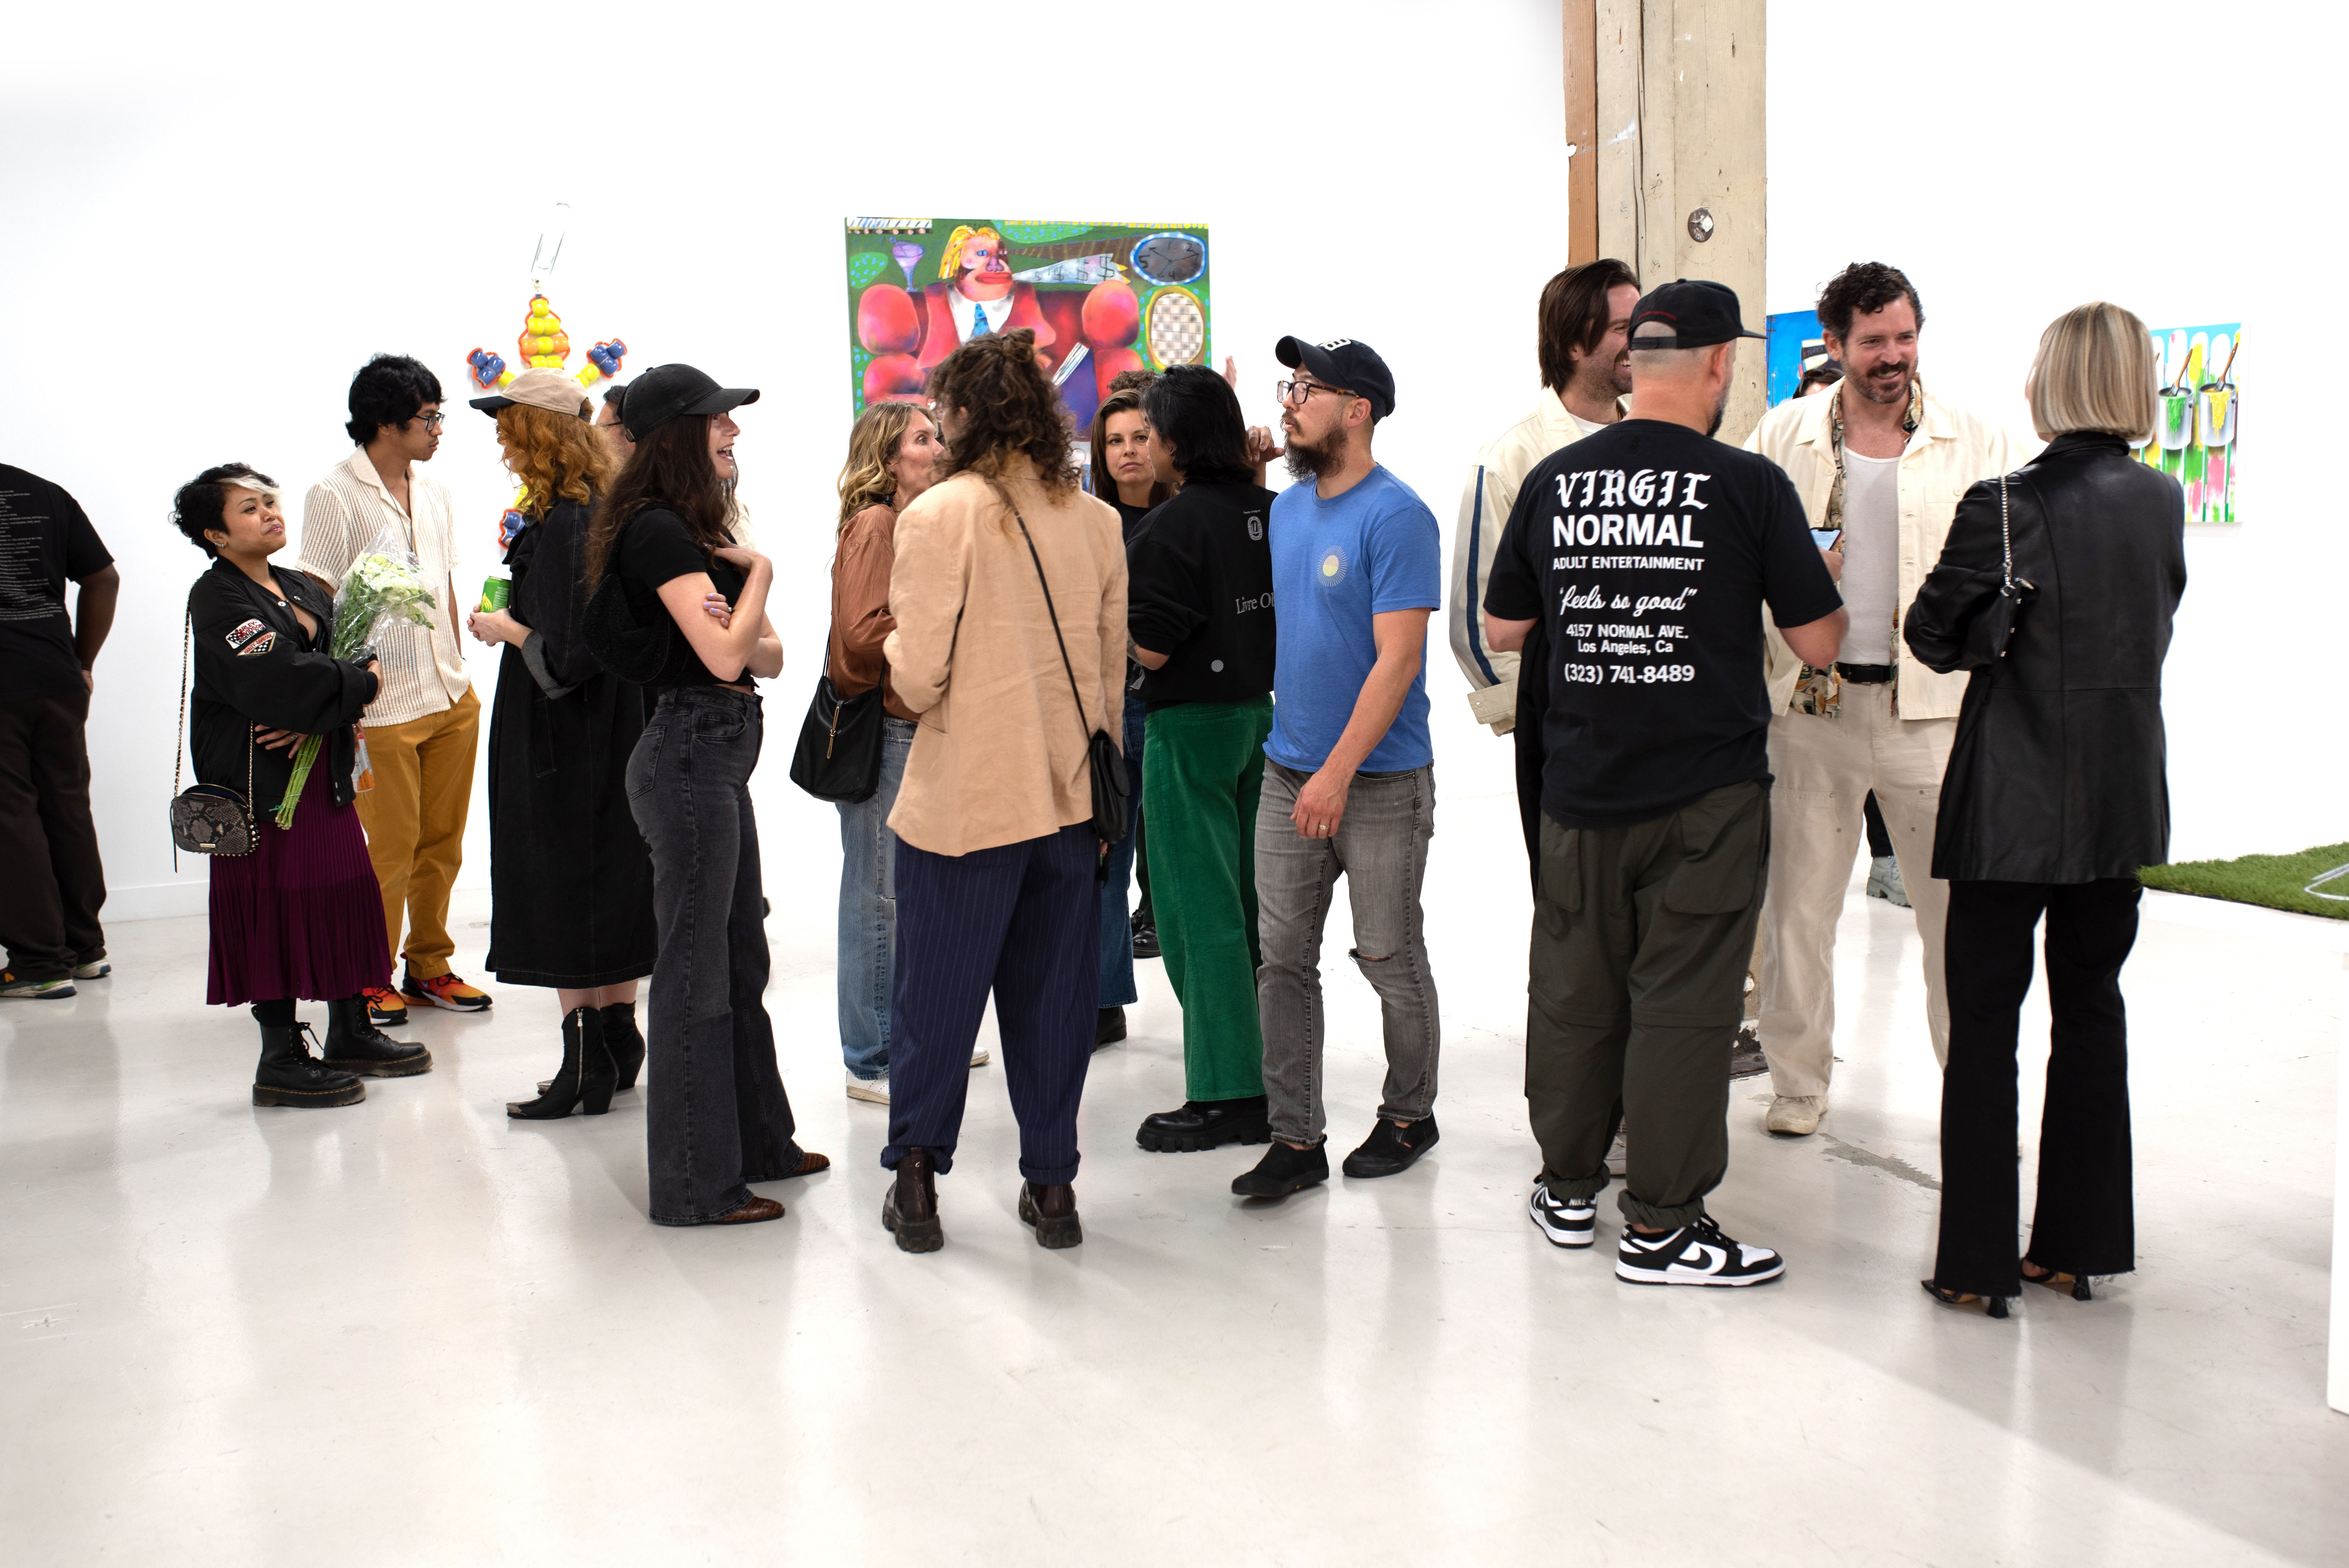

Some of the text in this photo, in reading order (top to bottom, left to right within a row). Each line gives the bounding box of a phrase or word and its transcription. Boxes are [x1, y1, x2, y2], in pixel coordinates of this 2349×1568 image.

[1555, 469, 1711, 510] VIRGIL
[1553, 513, 1704, 548] NORMAL
[1553, 556, 1705, 571] ADULT ENTERTAINMENT
[1235, 597, 1258, 614] Livre
[1611, 594, 1631, 609] so
[1566, 624, 1689, 639] 4157 NORMAL AVE.
[1578, 640, 1674, 656] Los Angeles, Ca
[1565, 663, 1695, 684] (323) 741-8489
